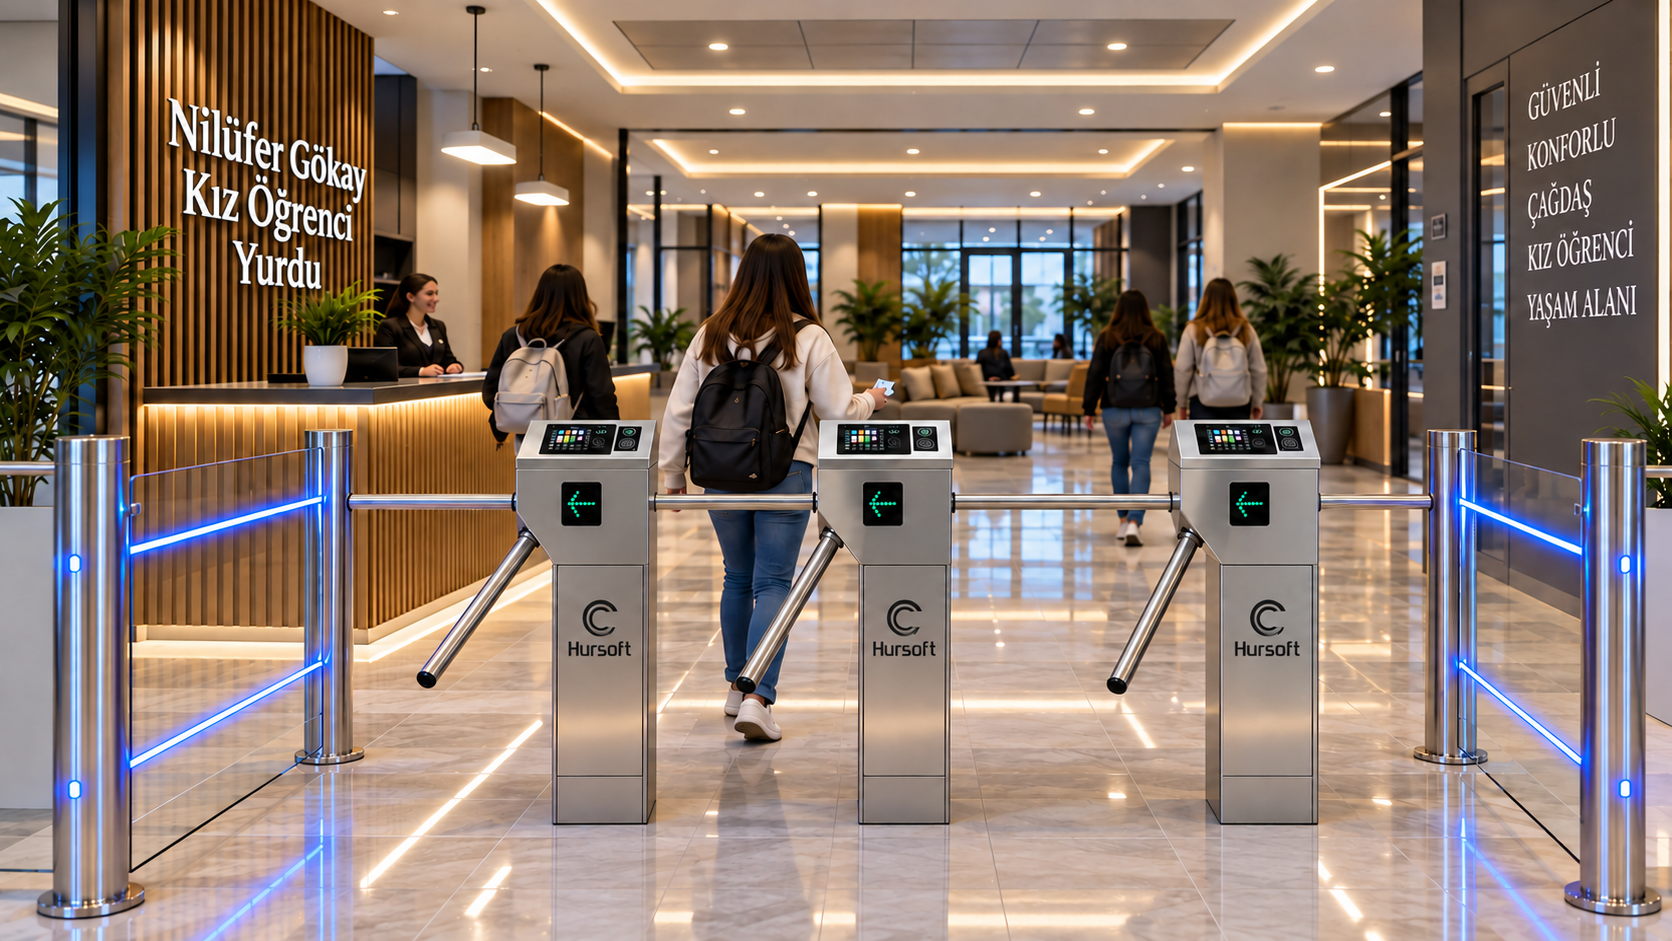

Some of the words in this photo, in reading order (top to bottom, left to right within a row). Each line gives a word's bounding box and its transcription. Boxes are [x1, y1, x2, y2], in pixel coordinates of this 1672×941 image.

[1528, 61, 1601, 121] GÜVENLİ
[167, 98, 284, 172] Nilüfer
[290, 139, 367, 204] Gökay
[1527, 117, 1616, 171] KONFORLU
[183, 168, 239, 222] Kız
[248, 174, 353, 242] Öğrenci
[1527, 178, 1592, 228] ÇAĞDAŞ
[232, 240, 322, 289] Yurdu
[1527, 242, 1552, 271] KIZ
[1556, 220, 1634, 267] ÖĞRENCİ
[1527, 290, 1578, 328] YAŞAM
[1582, 285, 1637, 318] ALANI
[568, 641, 631, 657] Hursoft
[873, 641, 936, 657] Hursoft
[1234, 641, 1300, 657] Hursoft
